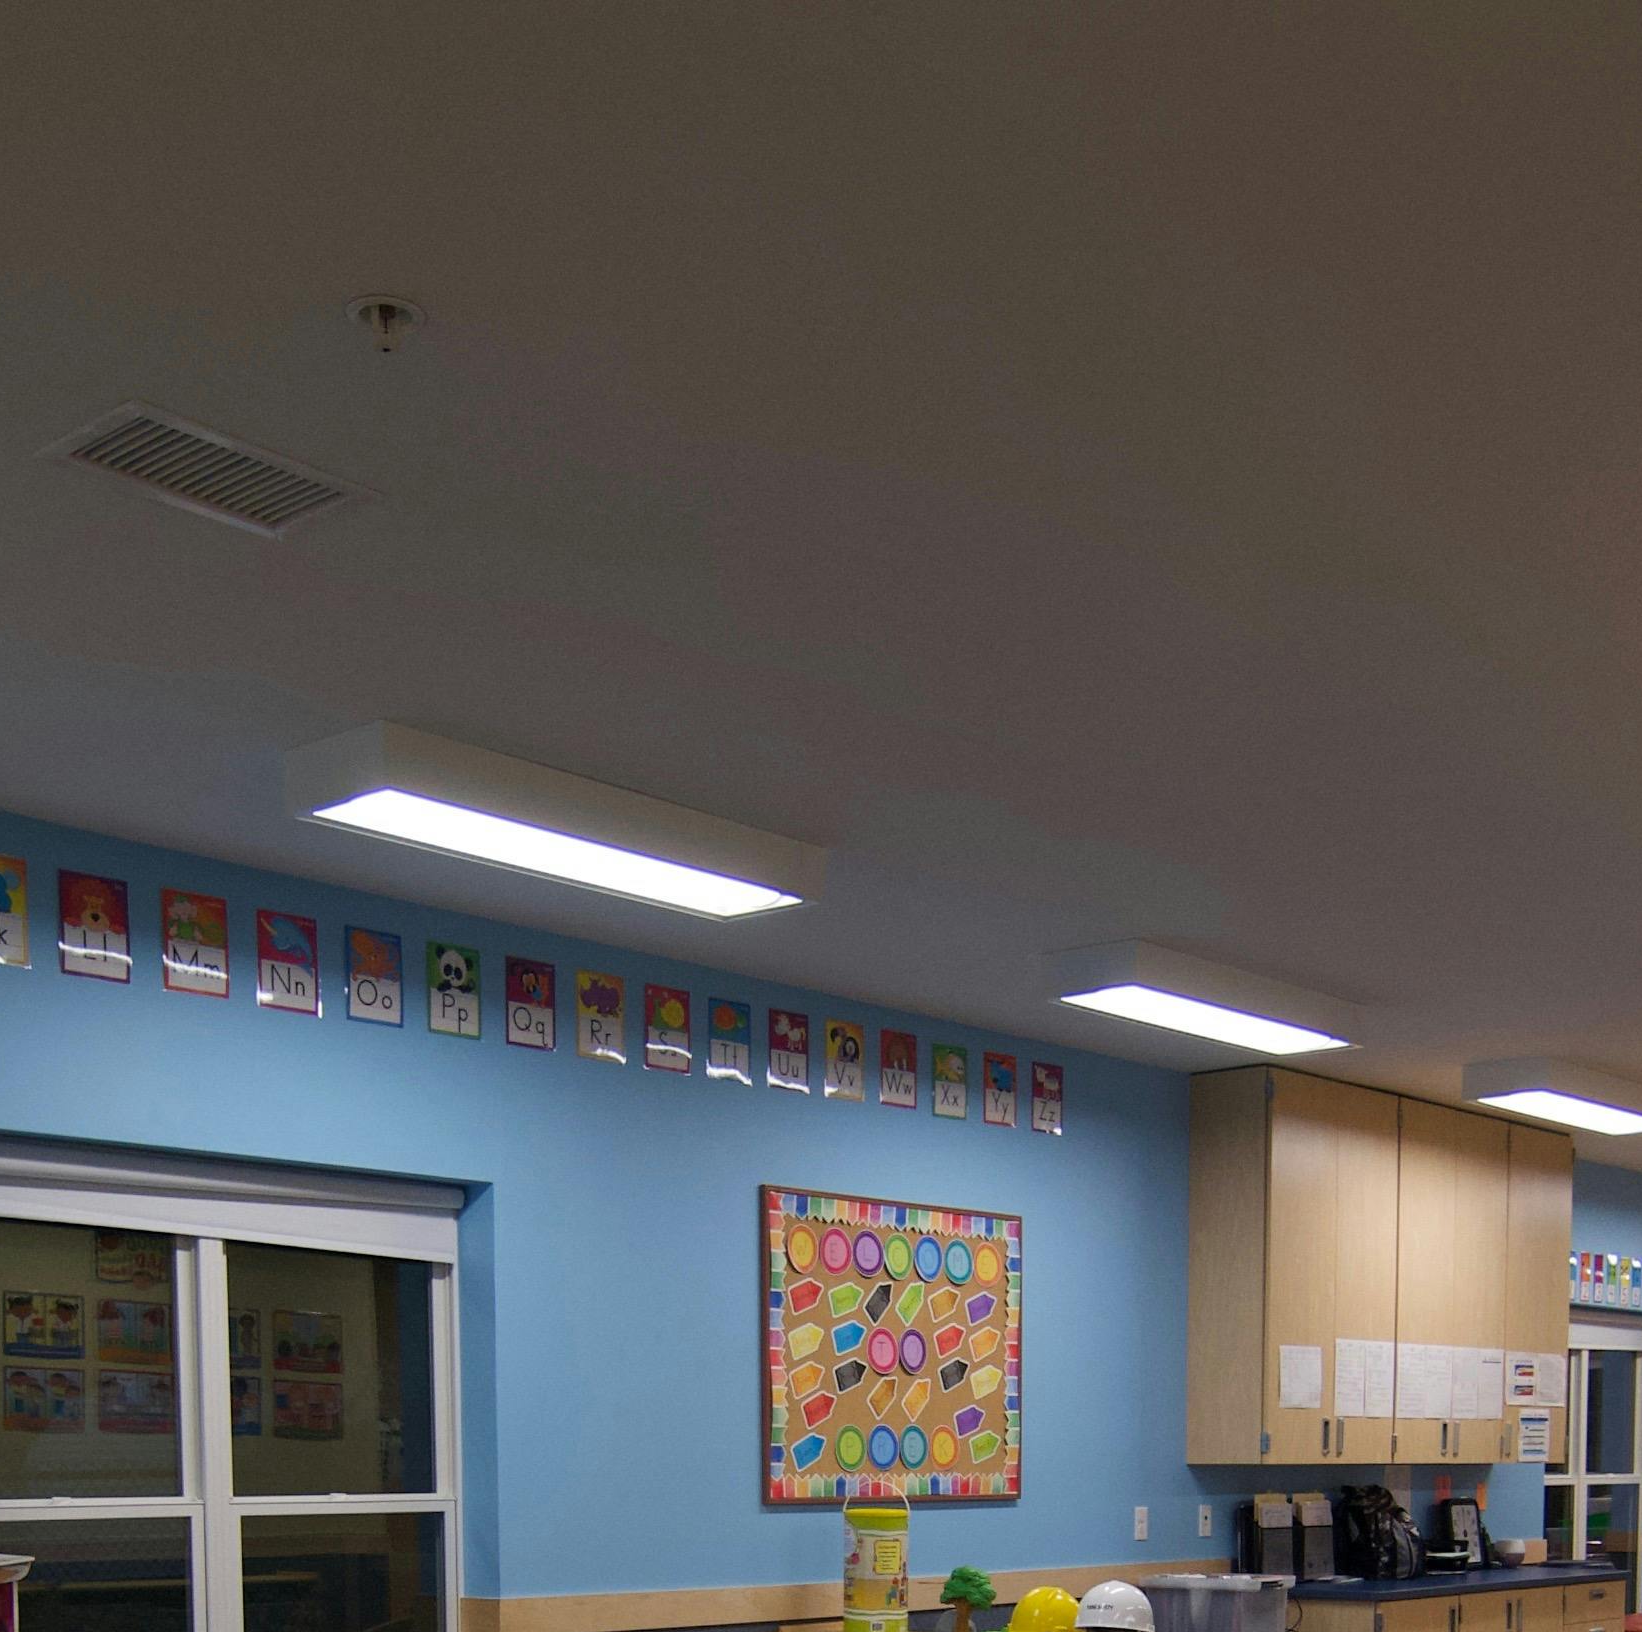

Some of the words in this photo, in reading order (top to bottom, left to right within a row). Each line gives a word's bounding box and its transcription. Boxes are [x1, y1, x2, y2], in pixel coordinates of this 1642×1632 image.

[172, 943, 224, 981] Mm
[270, 963, 306, 997] Nn
[356, 978, 394, 1010] Oo
[442, 992, 469, 1033] Pp
[512, 1006, 549, 1049] Qq
[590, 1018, 613, 1046] Rr
[777, 1054, 800, 1078] Uu
[833, 1063, 855, 1088] Vv
[884, 1070, 914, 1096] Ww
[940, 1084, 959, 1107] Xx
[991, 1091, 1009, 1121] Yy
[1039, 1100, 1056, 1123] Zz
[797, 1231, 989, 1274] WELCOME
[876, 1339, 919, 1365] TO
